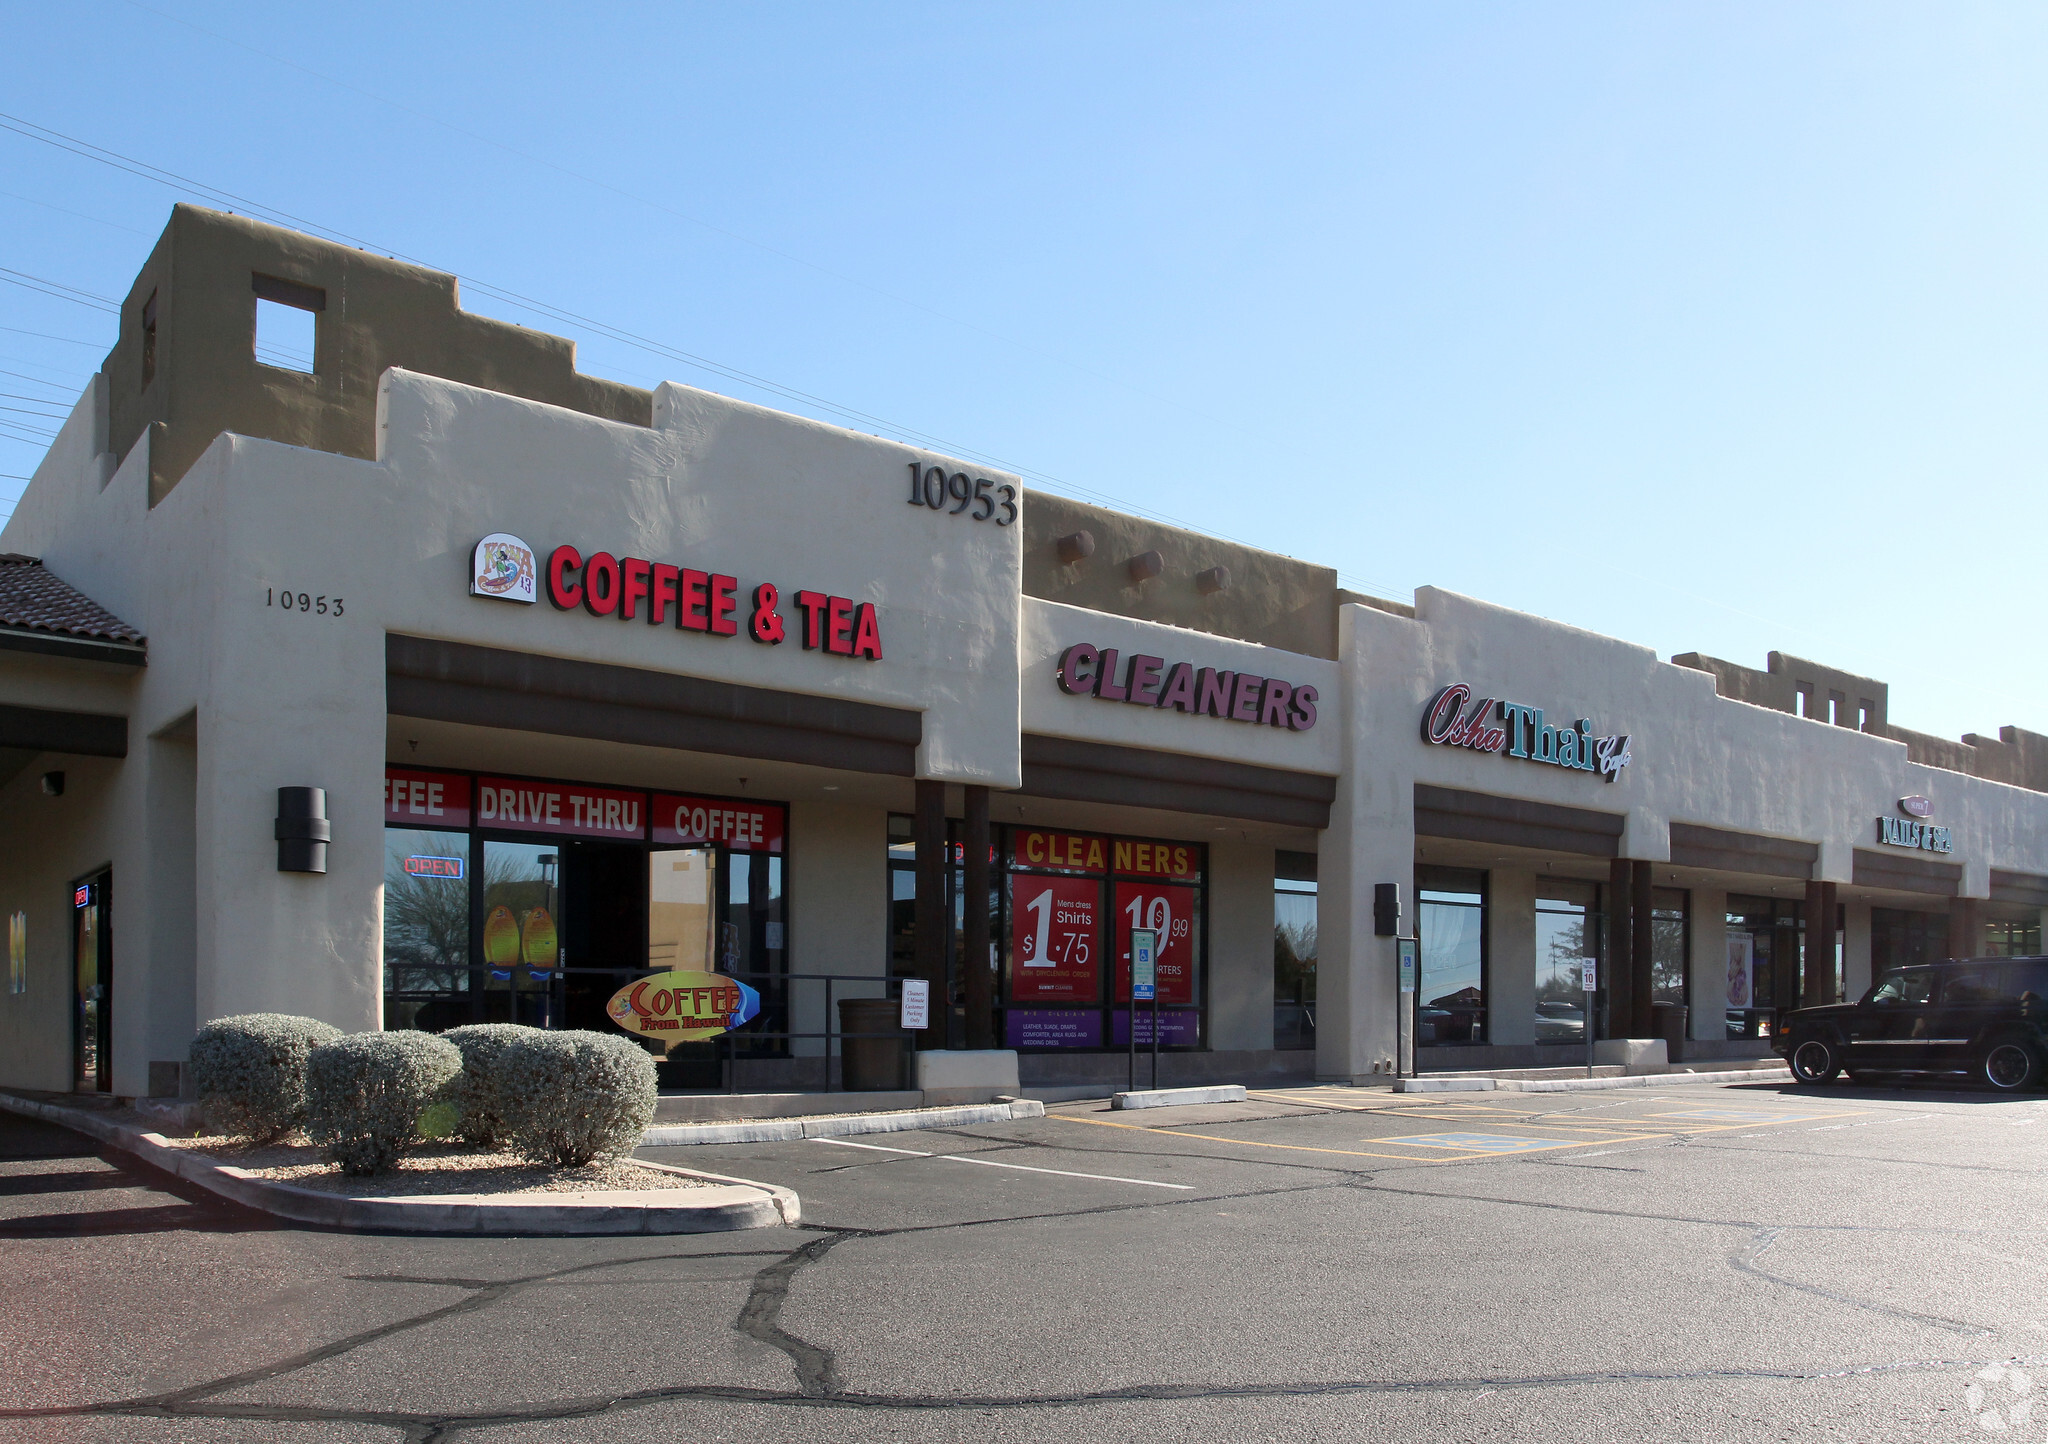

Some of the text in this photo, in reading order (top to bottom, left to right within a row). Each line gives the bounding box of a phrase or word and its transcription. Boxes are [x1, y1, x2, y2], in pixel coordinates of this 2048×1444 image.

[907, 461, 1018, 526] 10953
[520, 576, 532, 594] 13
[267, 587, 344, 617] 10953
[546, 544, 883, 661] COFFEE & TEA
[1056, 642, 1319, 732] CLEANERS
[1421, 683, 1505, 753] Osha
[1497, 700, 1595, 772] Thai
[480, 786, 561, 826] DRIVE
[569, 795, 639, 832] THRU
[675, 805, 764, 843] COFFEE
[1924, 800, 1929, 815] 7
[1877, 816, 1954, 853] NAILS & SPA
[404, 857, 459, 876] OPEN
[1056, 911, 1092, 925] Shirts
[1057, 899, 1092, 910] Mens dress
[1584, 973, 1593, 983] 10
[629, 981, 740, 1016] COFFEE
[640, 1014, 732, 1031] From Hawaii
